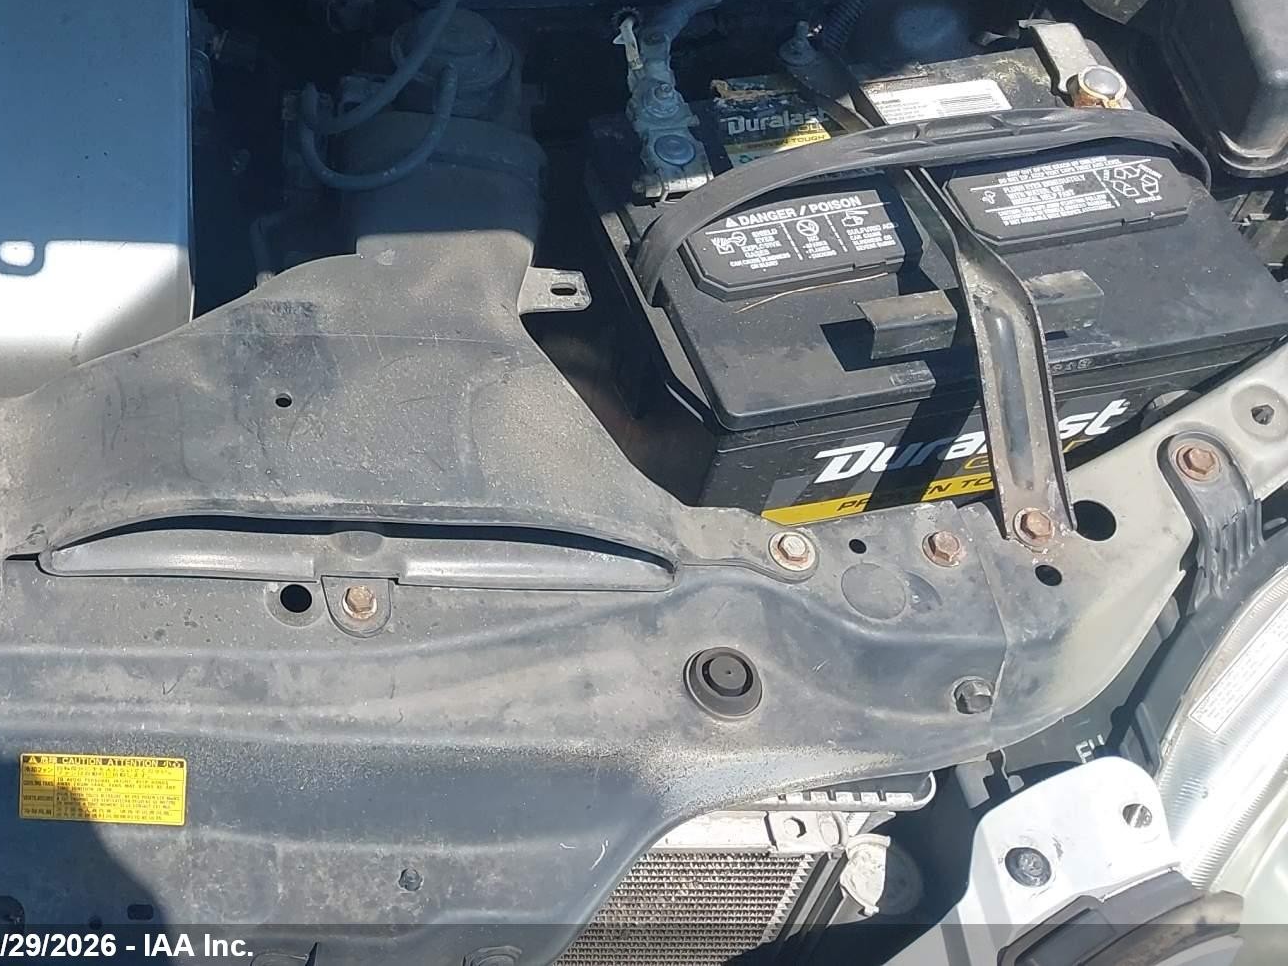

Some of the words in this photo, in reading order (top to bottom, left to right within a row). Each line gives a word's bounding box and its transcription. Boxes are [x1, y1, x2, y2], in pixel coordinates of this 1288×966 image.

[738, 207, 797, 226] DANGER
[807, 196, 863, 213] POISON
[812, 398, 1131, 485] Durast
[62, 757, 101, 765] CAUTION
[107, 758, 159, 767] ATTENTION
